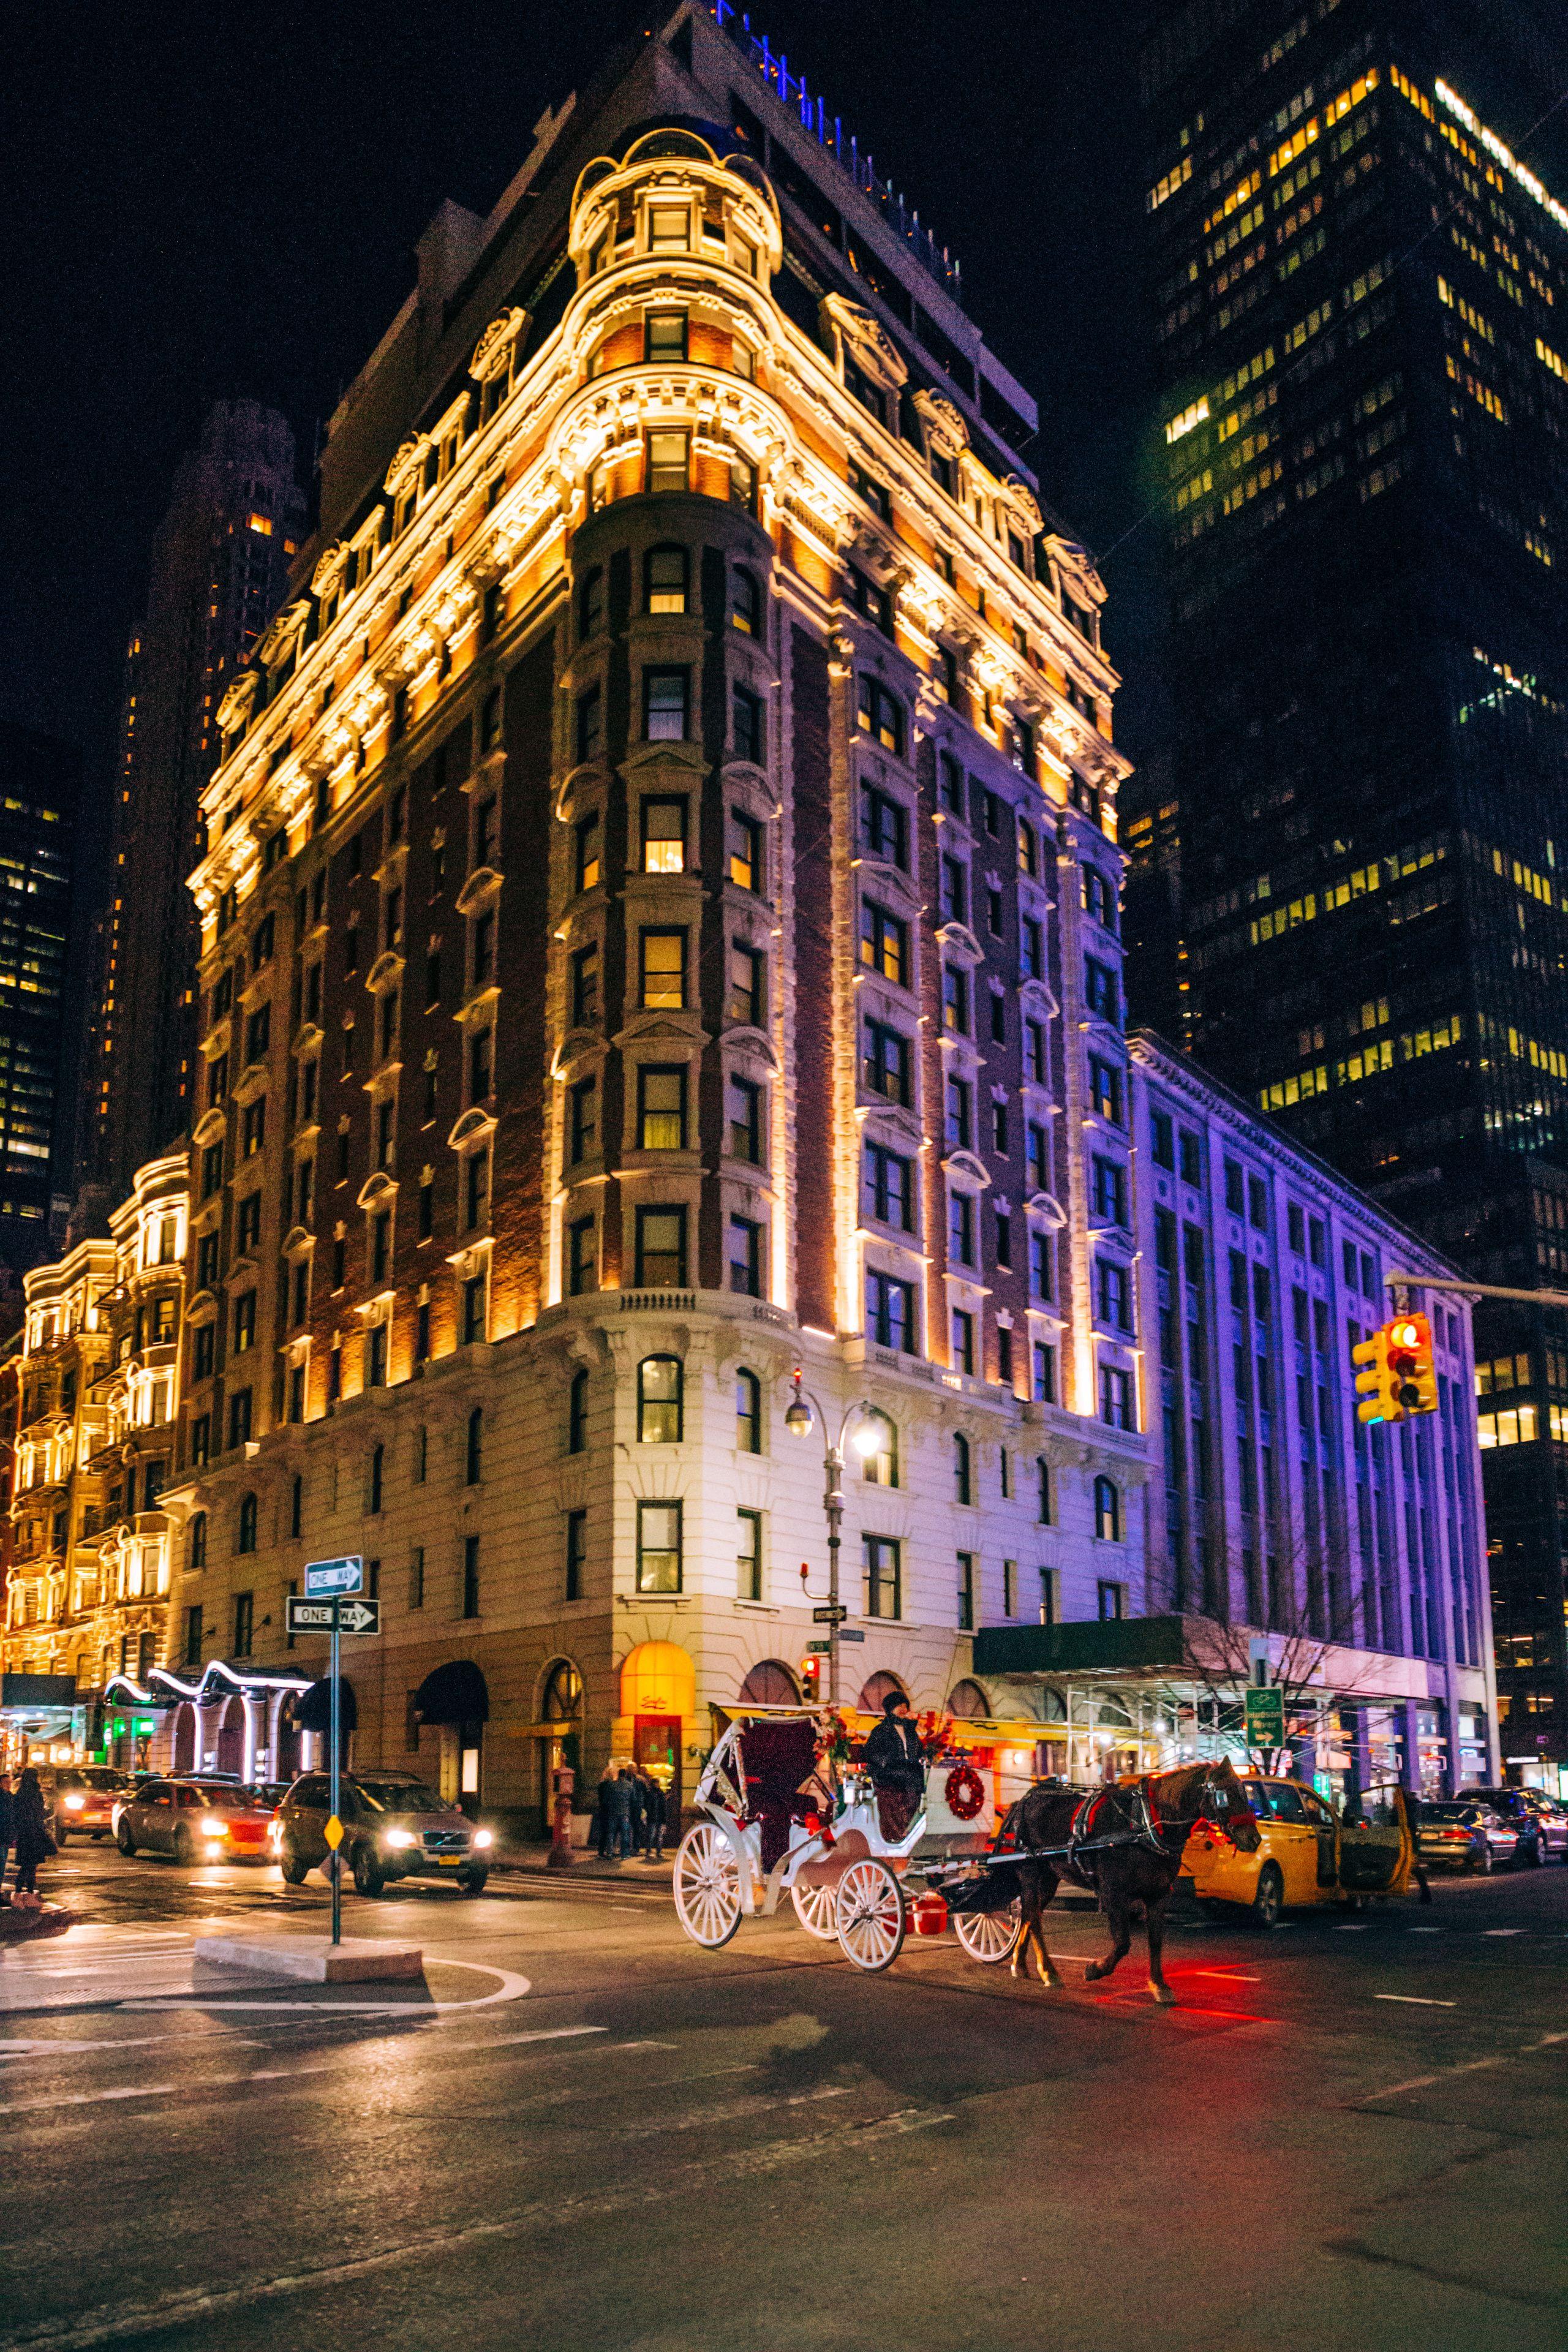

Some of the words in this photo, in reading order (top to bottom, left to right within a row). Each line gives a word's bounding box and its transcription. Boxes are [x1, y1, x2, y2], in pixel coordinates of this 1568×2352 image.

[311, 1572, 328, 1586] ONE
[337, 1568, 353, 1582] WAY
[301, 1608, 328, 1621] ONE
[339, 1610, 366, 1623] WAY
